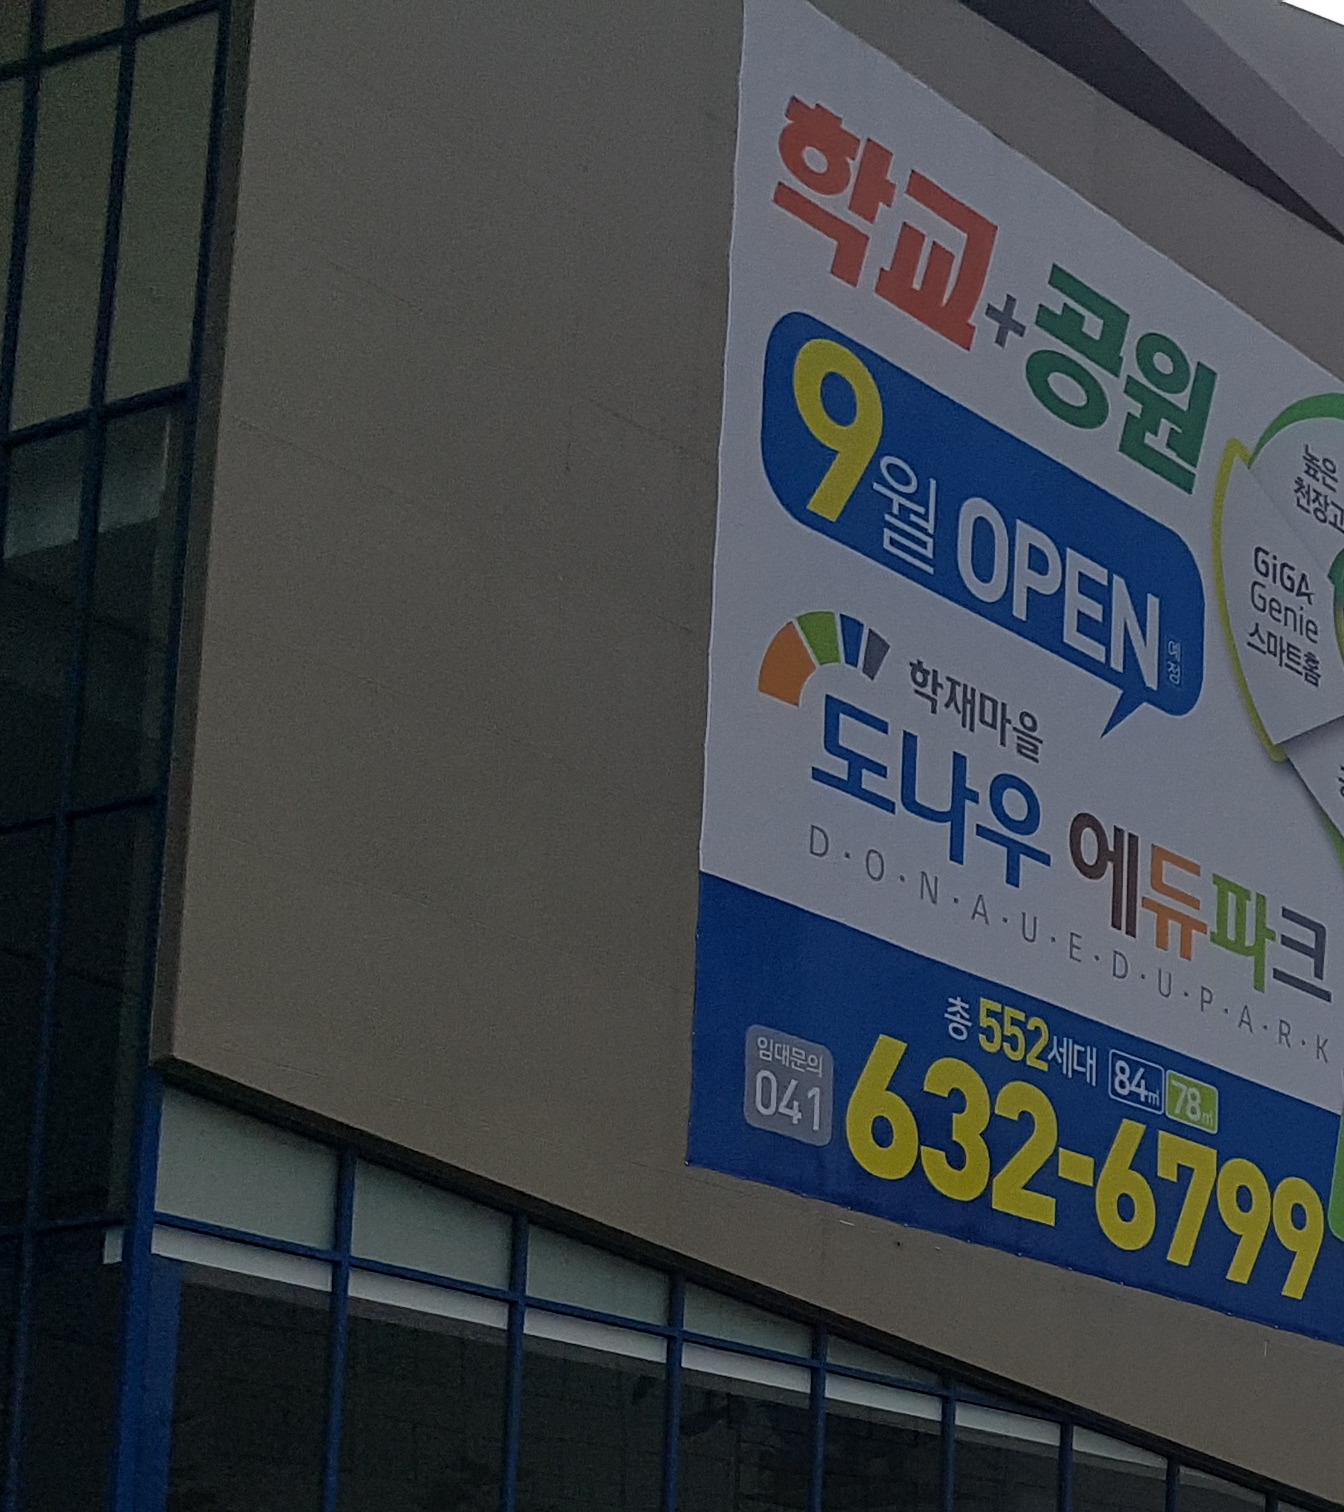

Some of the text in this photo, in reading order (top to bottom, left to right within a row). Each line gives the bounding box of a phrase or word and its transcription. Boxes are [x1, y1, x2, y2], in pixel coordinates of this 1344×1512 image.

[1303, 444, 1338, 493] 높은
[957, 497, 1160, 690] OPEN
[1254, 545, 1314, 604] GiGA
[1250, 581, 1319, 644] Genie
[1246, 621, 1321, 687] 스마트홈
[908, 658, 1043, 764] 학재마을
[811, 694, 1332, 1003] 도나우 에듀파크
[944, 996, 972, 1042] 총
[756, 1035, 823, 1077] 임대문의
[755, 1033, 1324, 1300] 041 632-6799
